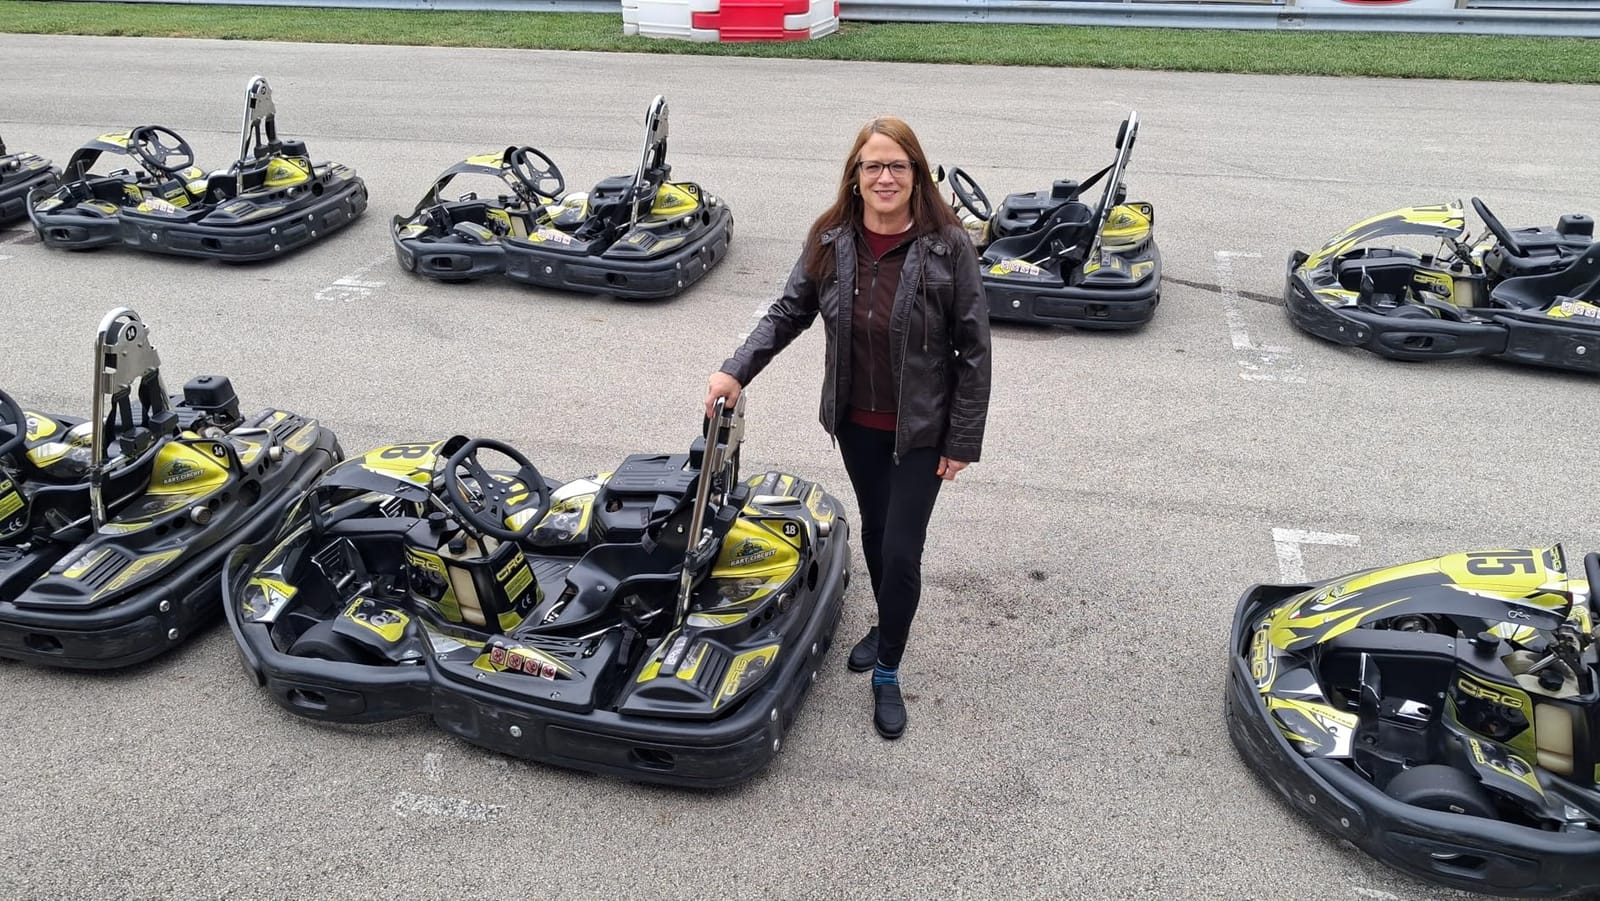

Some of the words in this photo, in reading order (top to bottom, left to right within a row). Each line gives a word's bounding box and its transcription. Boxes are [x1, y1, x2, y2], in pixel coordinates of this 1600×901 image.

[214, 446, 223, 456] 14
[785, 524, 796, 535] 18
[496, 551, 524, 581] CRG
[730, 557, 749, 567] KART
[750, 549, 776, 561] CIRCUIT
[1466, 549, 1537, 575] 15
[1251, 629, 1268, 680] CRG
[1458, 679, 1523, 708] CRG
